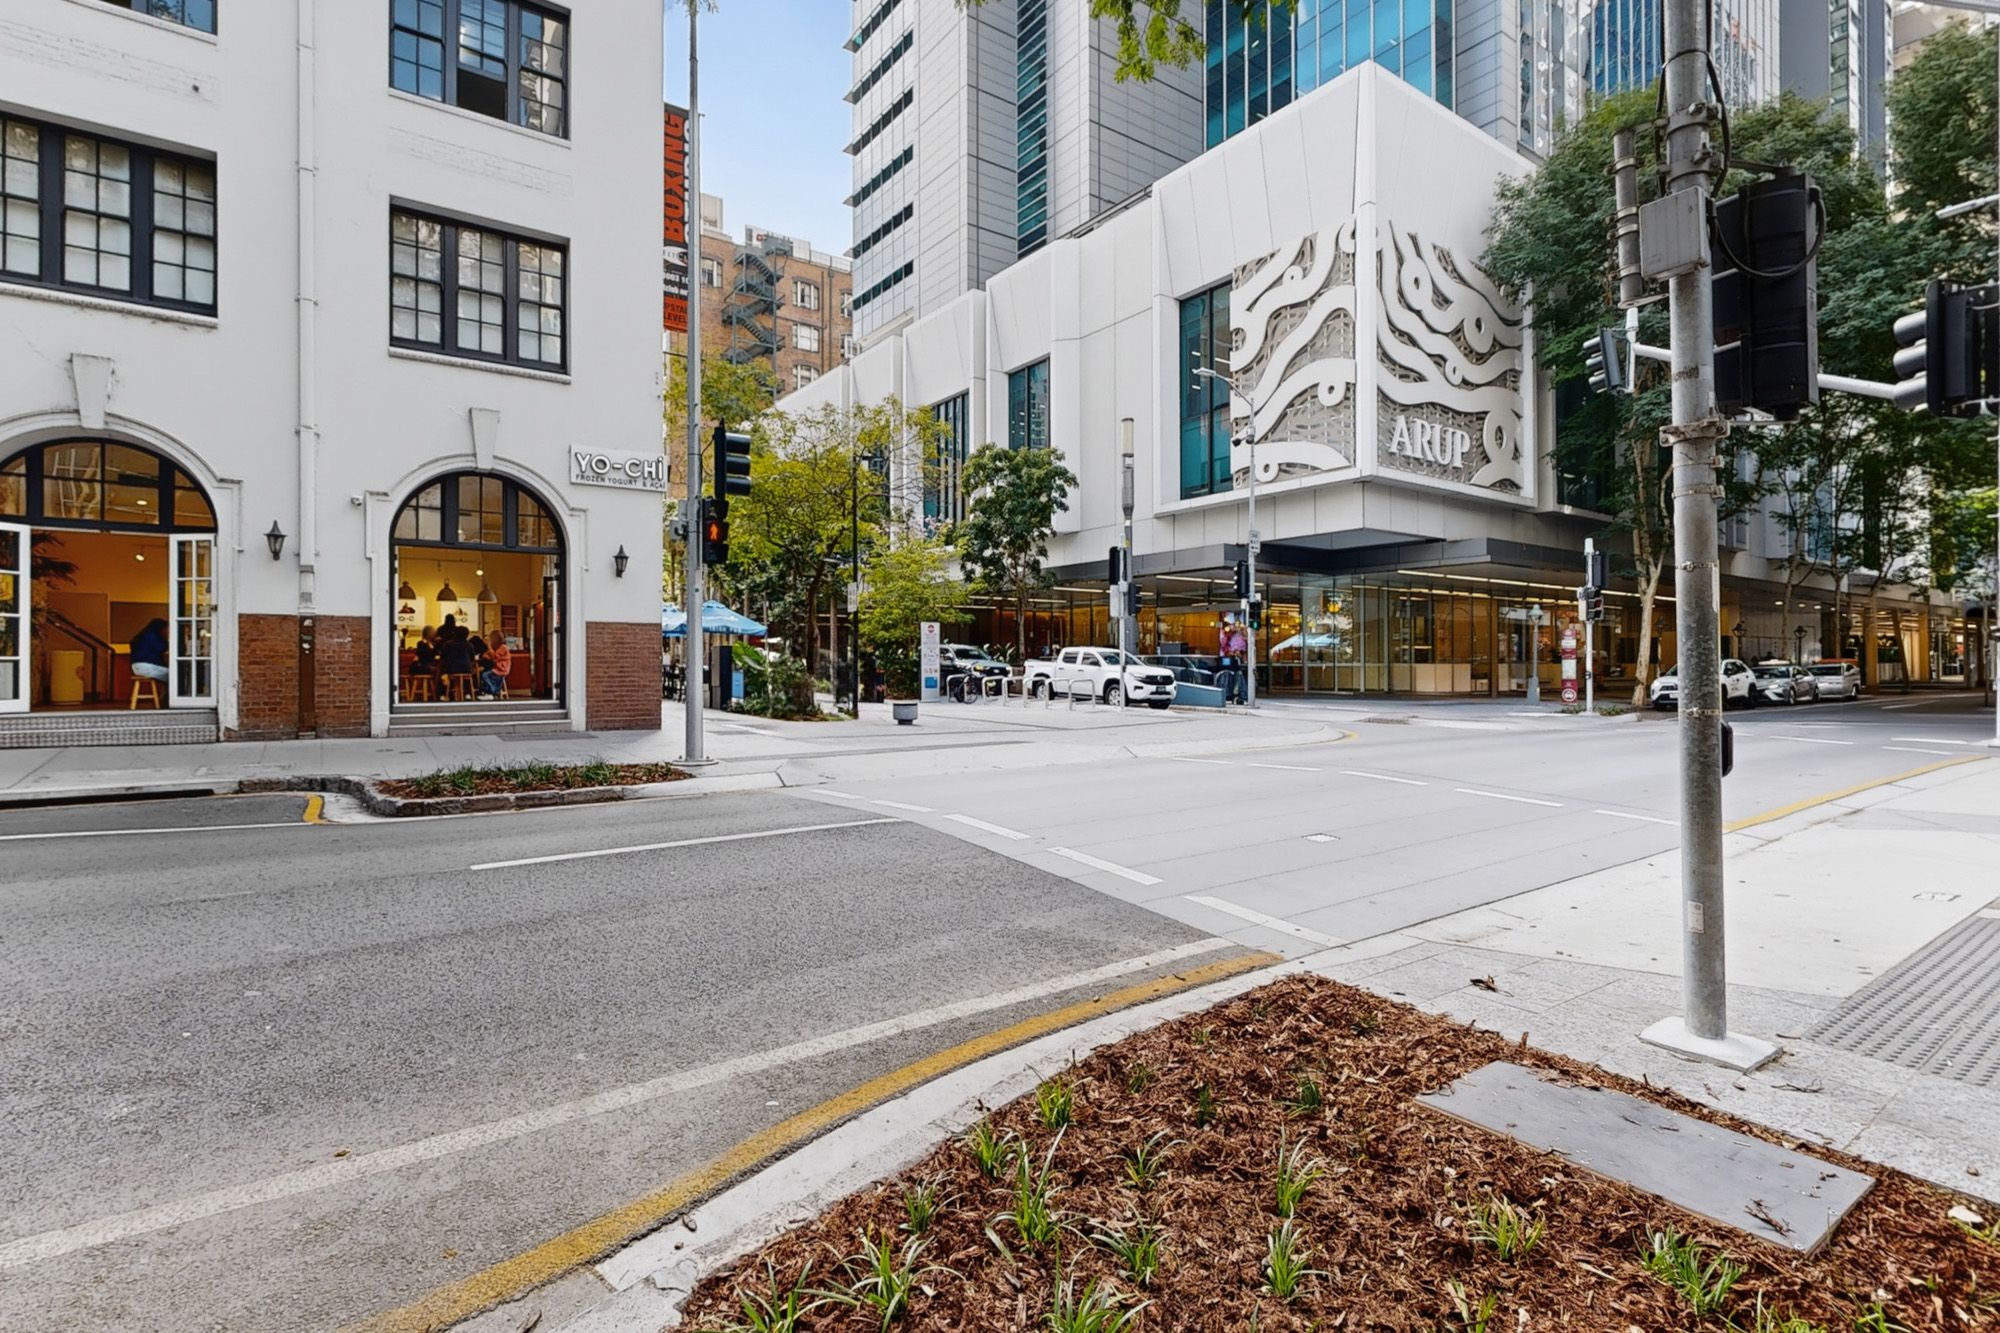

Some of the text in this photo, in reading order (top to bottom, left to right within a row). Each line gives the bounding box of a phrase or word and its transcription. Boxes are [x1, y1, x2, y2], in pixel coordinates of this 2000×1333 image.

[664, 112, 684, 243] BOXING
[1388, 414, 1471, 469] ARUP
[575, 474, 606, 483] FROZEN
[608, 478, 638, 487] YOGURT
